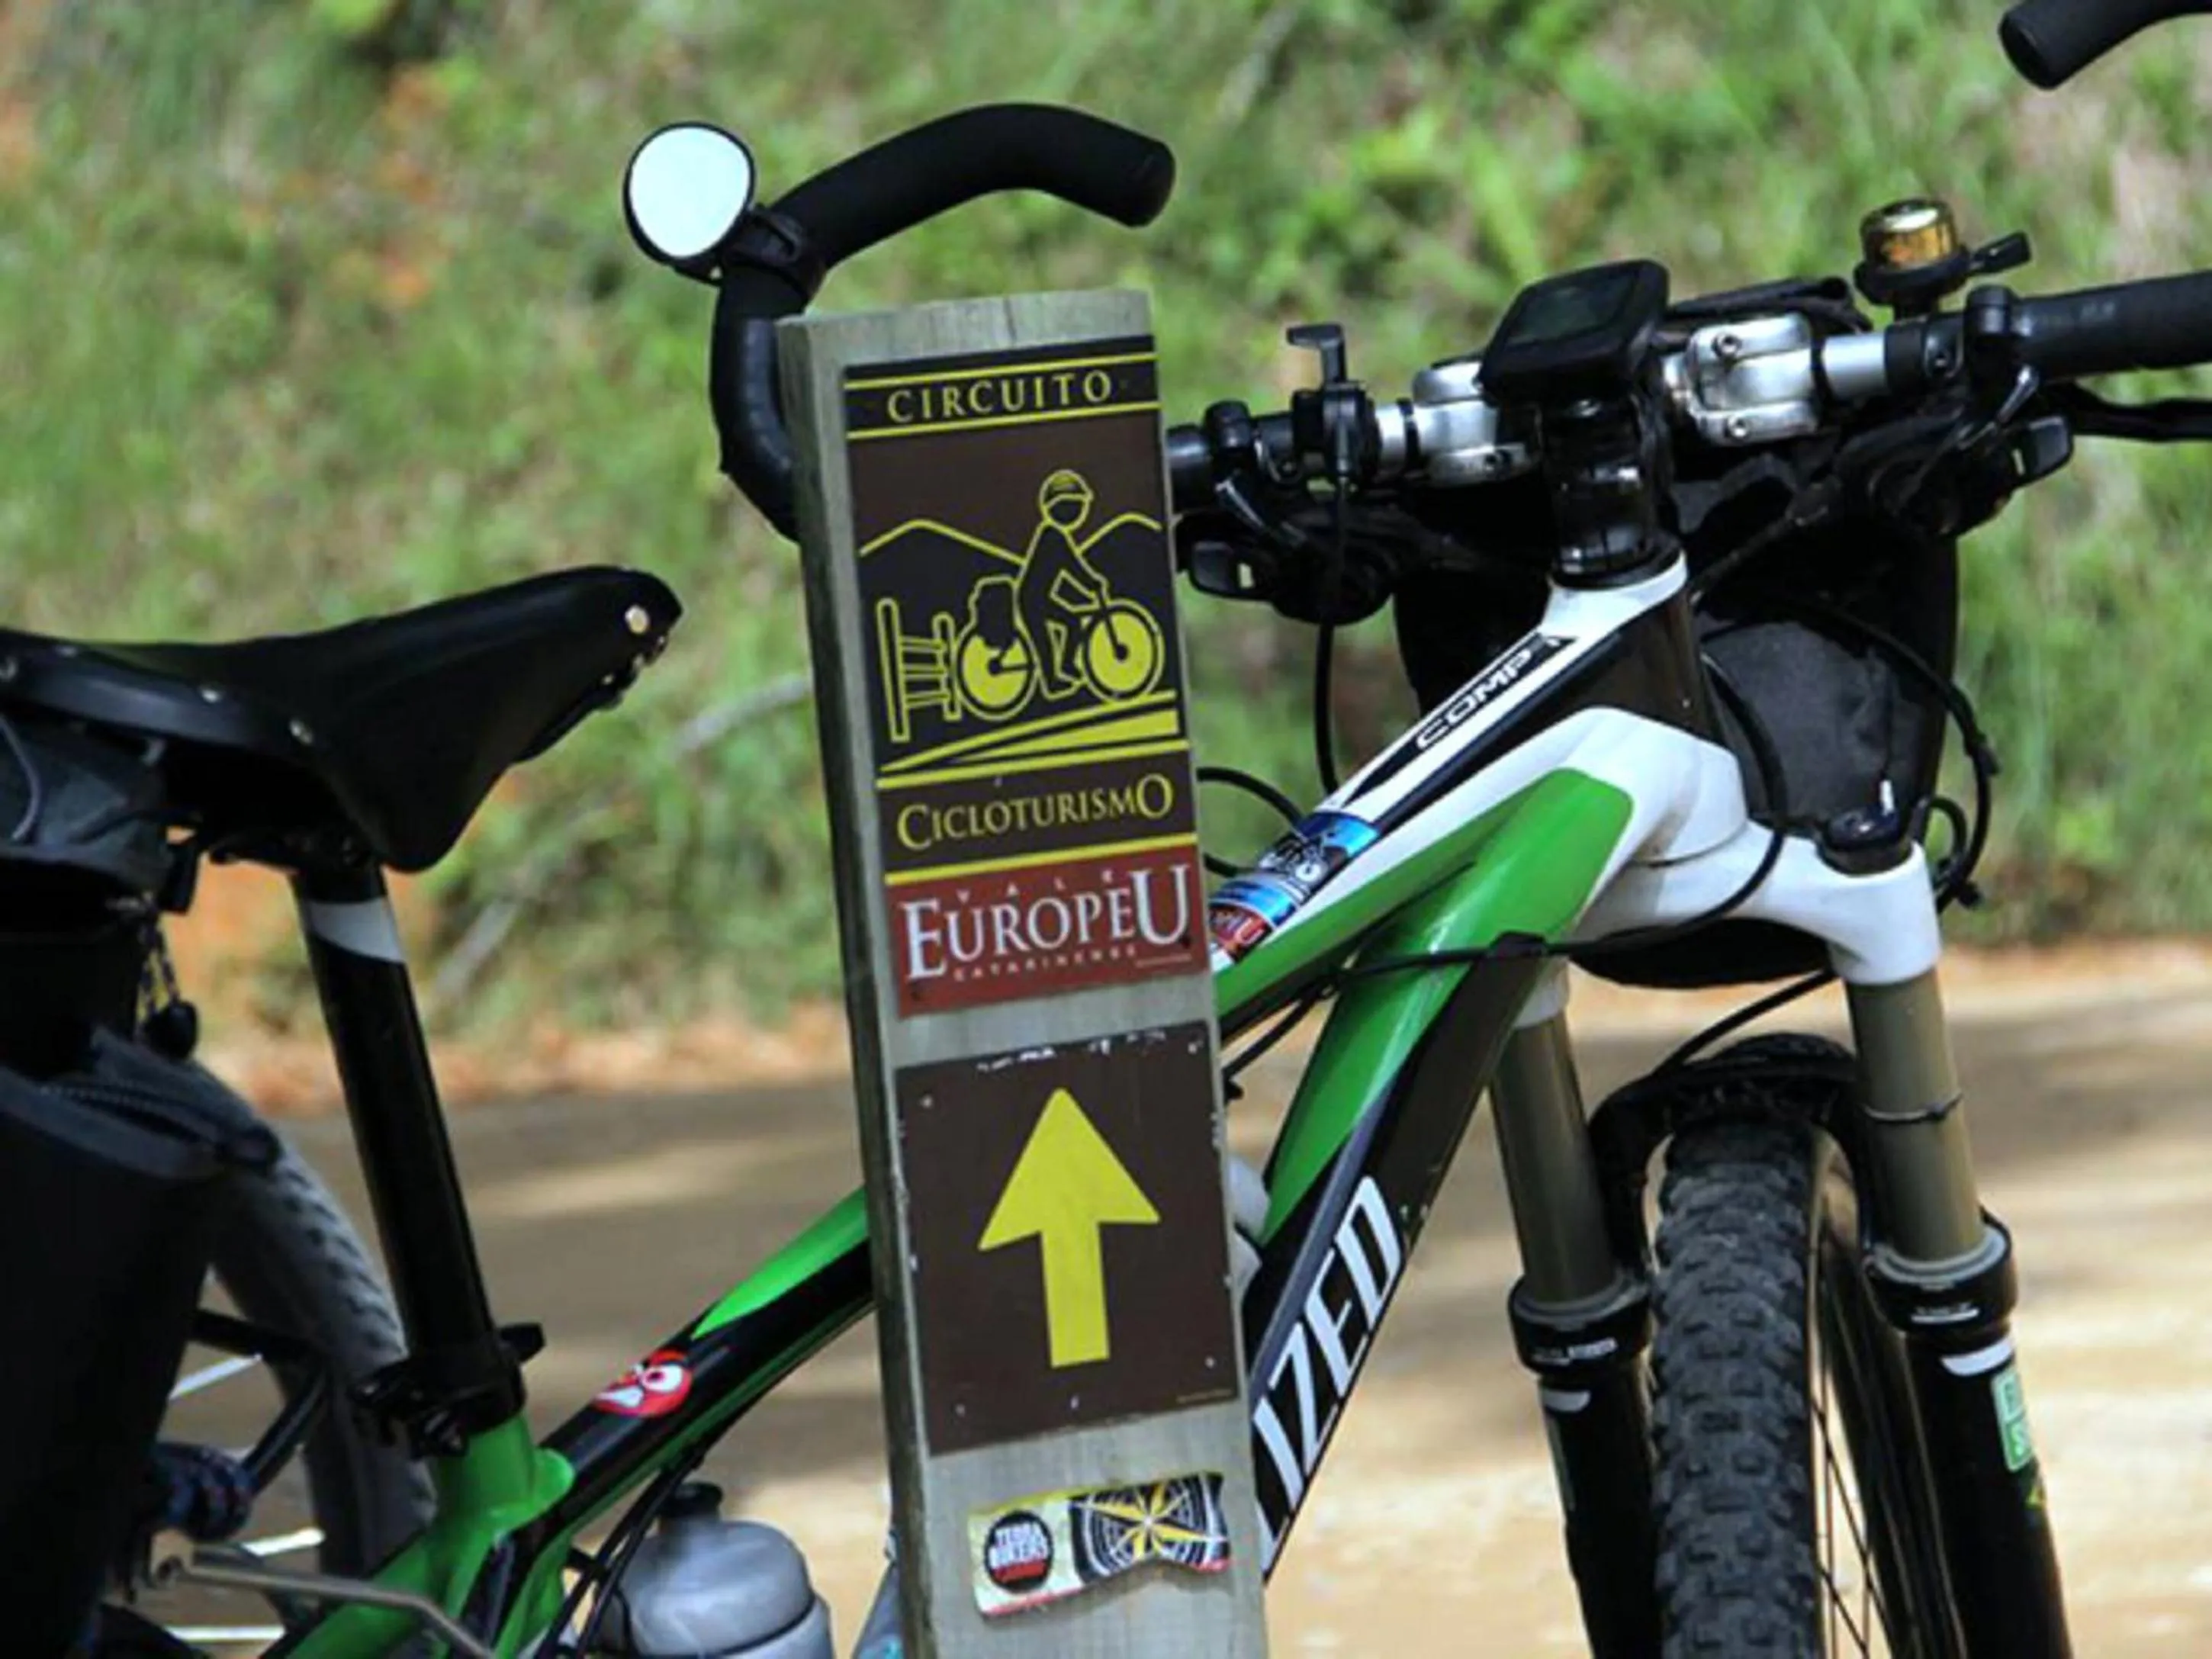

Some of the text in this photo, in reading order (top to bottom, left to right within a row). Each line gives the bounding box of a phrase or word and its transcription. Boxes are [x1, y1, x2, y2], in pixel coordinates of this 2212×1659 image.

[887, 370, 1113, 423] CIRCUITO
[1416, 648, 1532, 751] COMP
[896, 773, 1174, 850] CICLOTURISMO
[901, 863, 1190, 982] EUROPEU
[956, 870, 1114, 904] VALE
